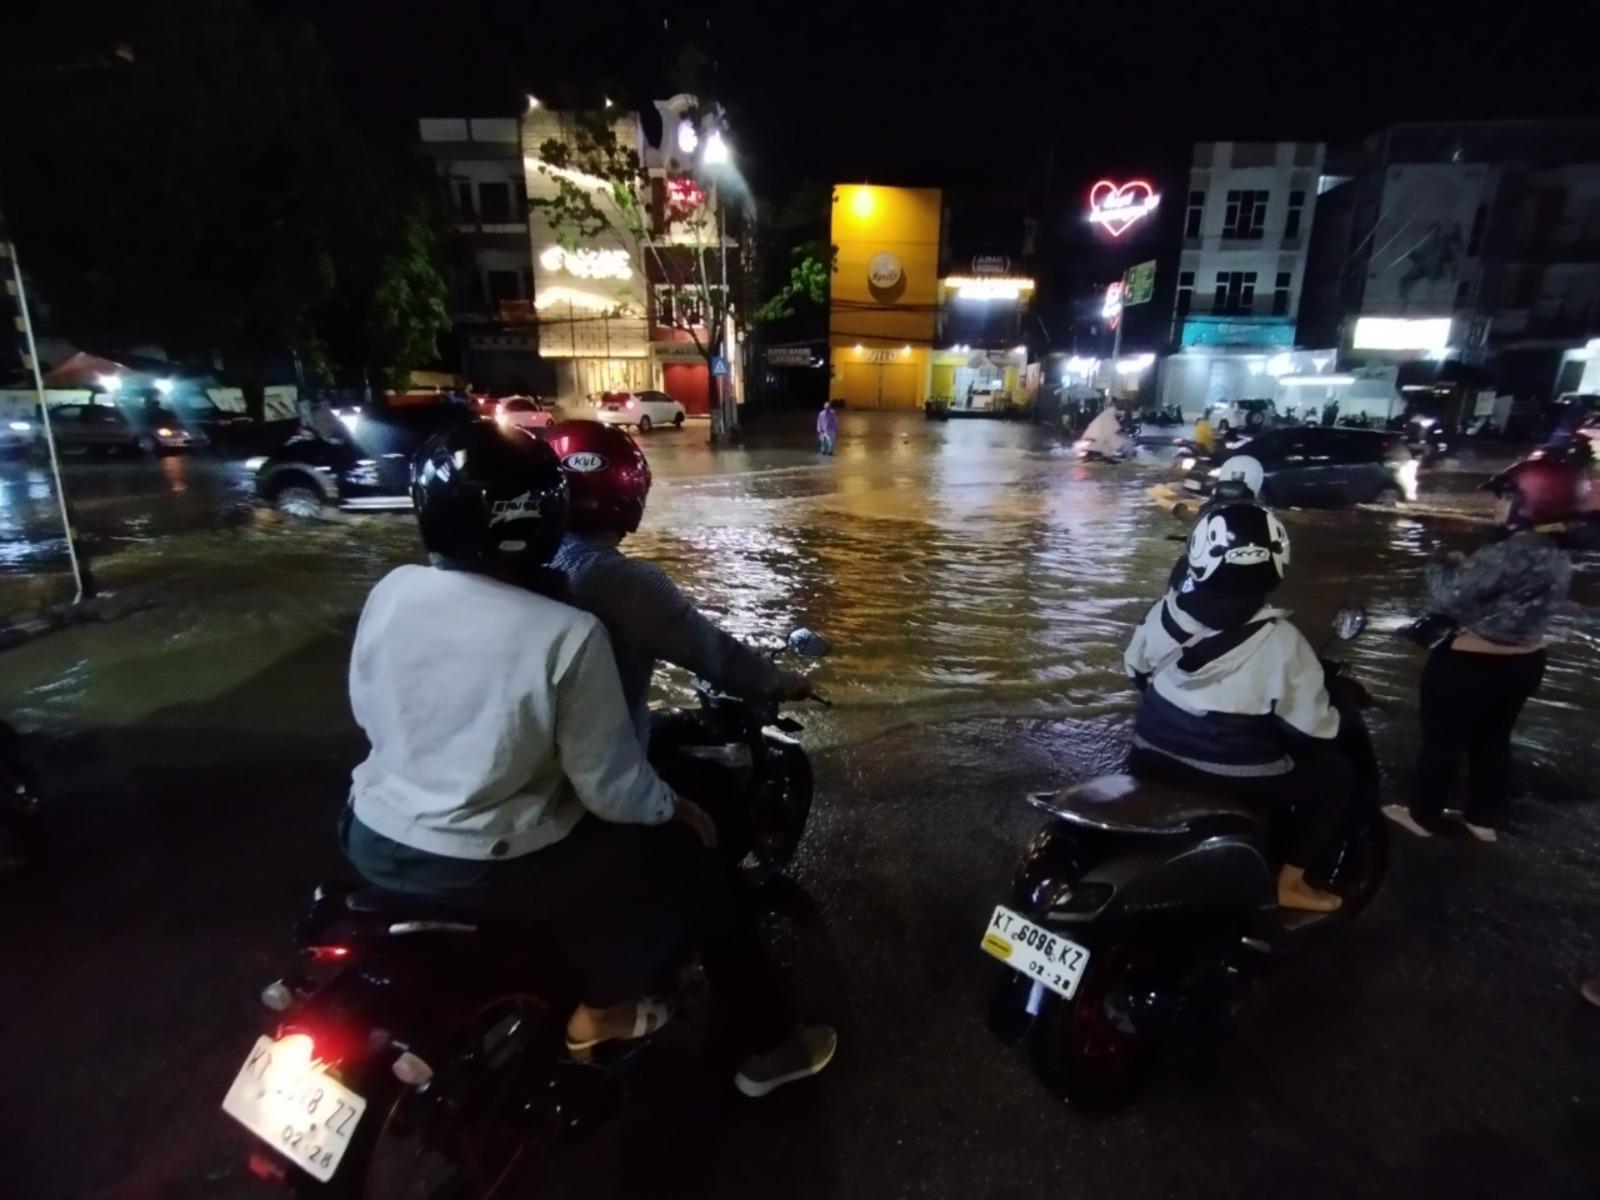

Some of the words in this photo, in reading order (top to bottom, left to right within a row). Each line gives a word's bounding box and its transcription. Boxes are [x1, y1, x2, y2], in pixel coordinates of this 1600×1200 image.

[992, 912, 1014, 932] KT
[1018, 925, 1057, 956] 6096
[1059, 945, 1083, 971] KZ
[325, 1098, 357, 1137] ZZ
